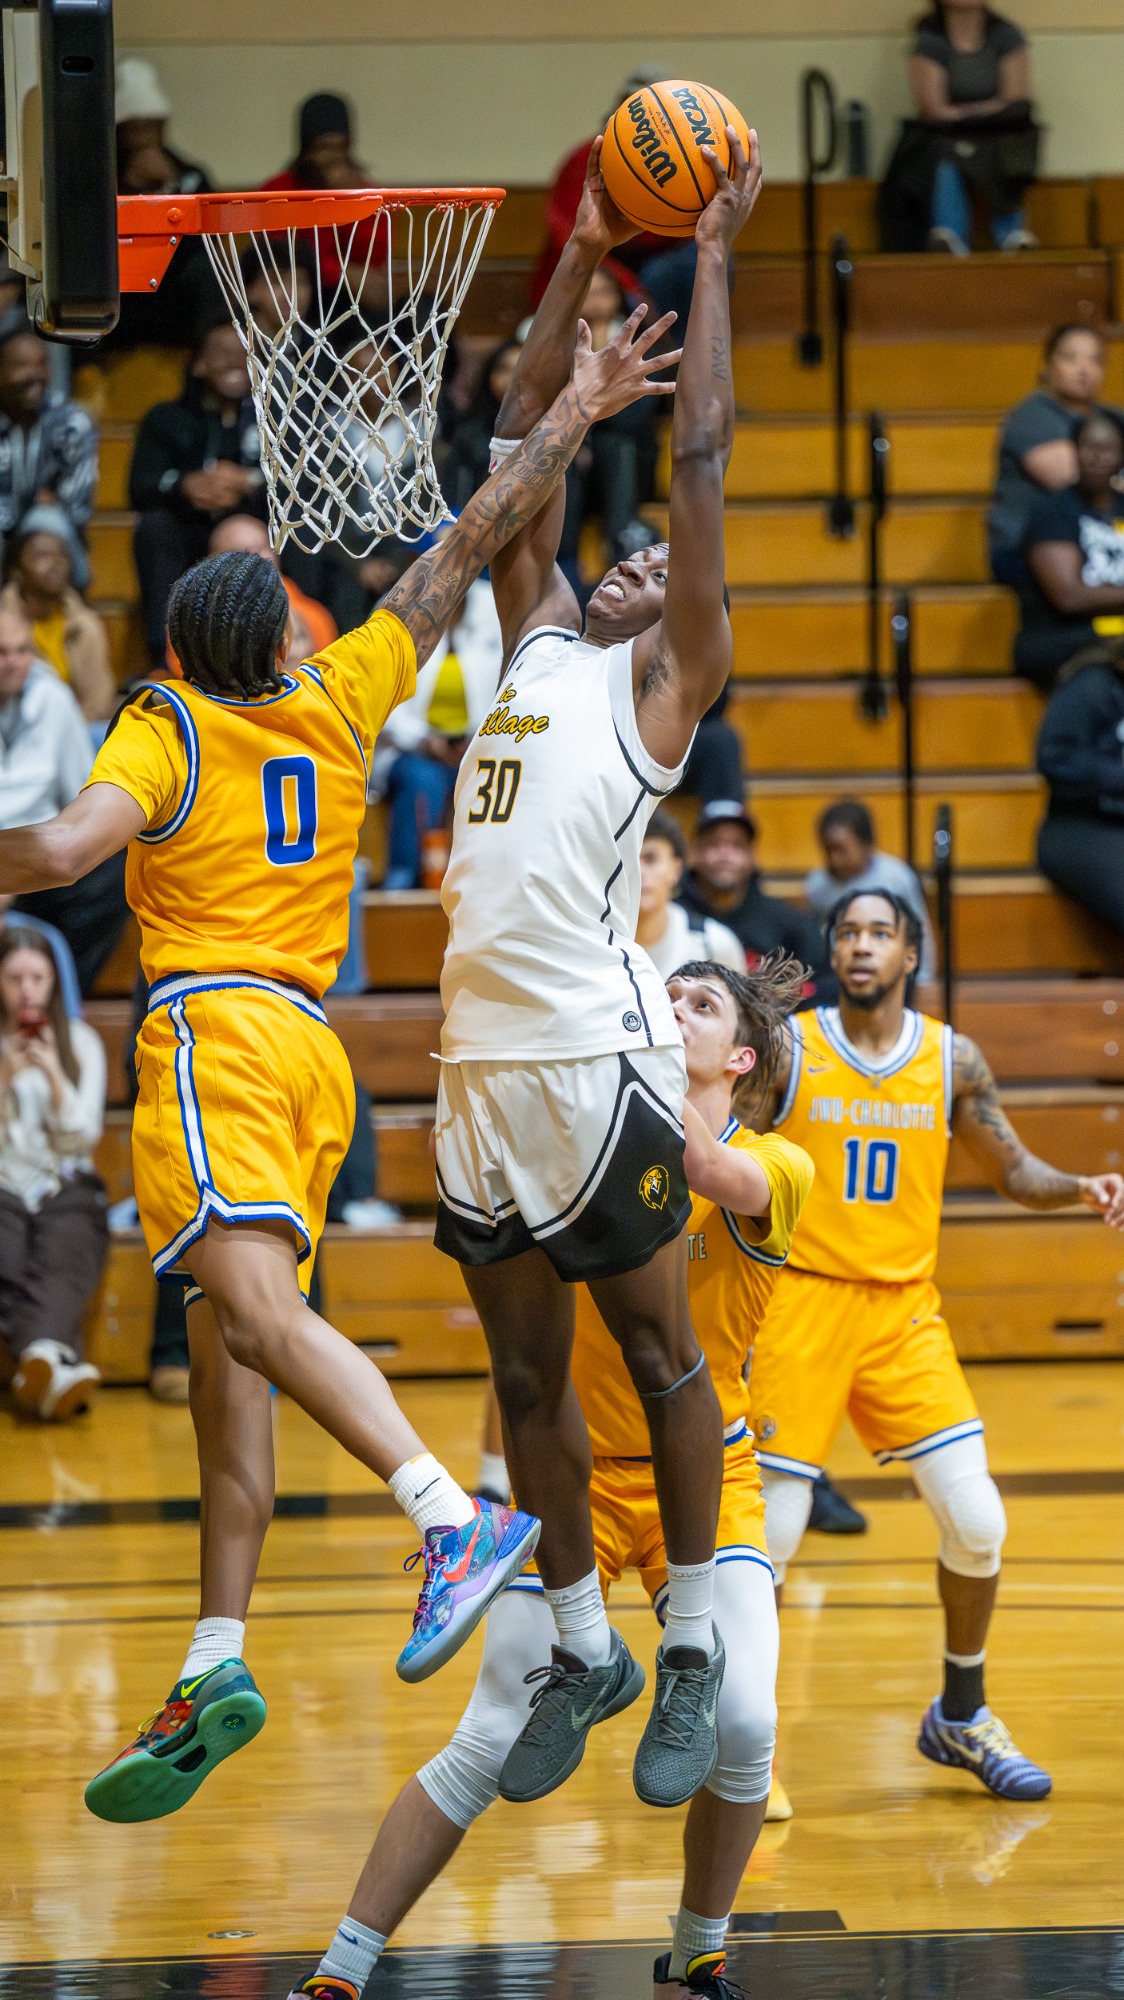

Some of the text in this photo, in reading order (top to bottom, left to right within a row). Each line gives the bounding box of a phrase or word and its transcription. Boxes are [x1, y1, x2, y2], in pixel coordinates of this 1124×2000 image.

[627, 94, 677, 189] Wilson
[671, 87, 716, 147] NCAA
[479, 706, 549, 743] illage
[261, 754, 318, 867] 0
[468, 757, 522, 824] 30
[809, 1096, 935, 1130] JWU-CHARLOTTE
[842, 1136, 901, 1206] 10
